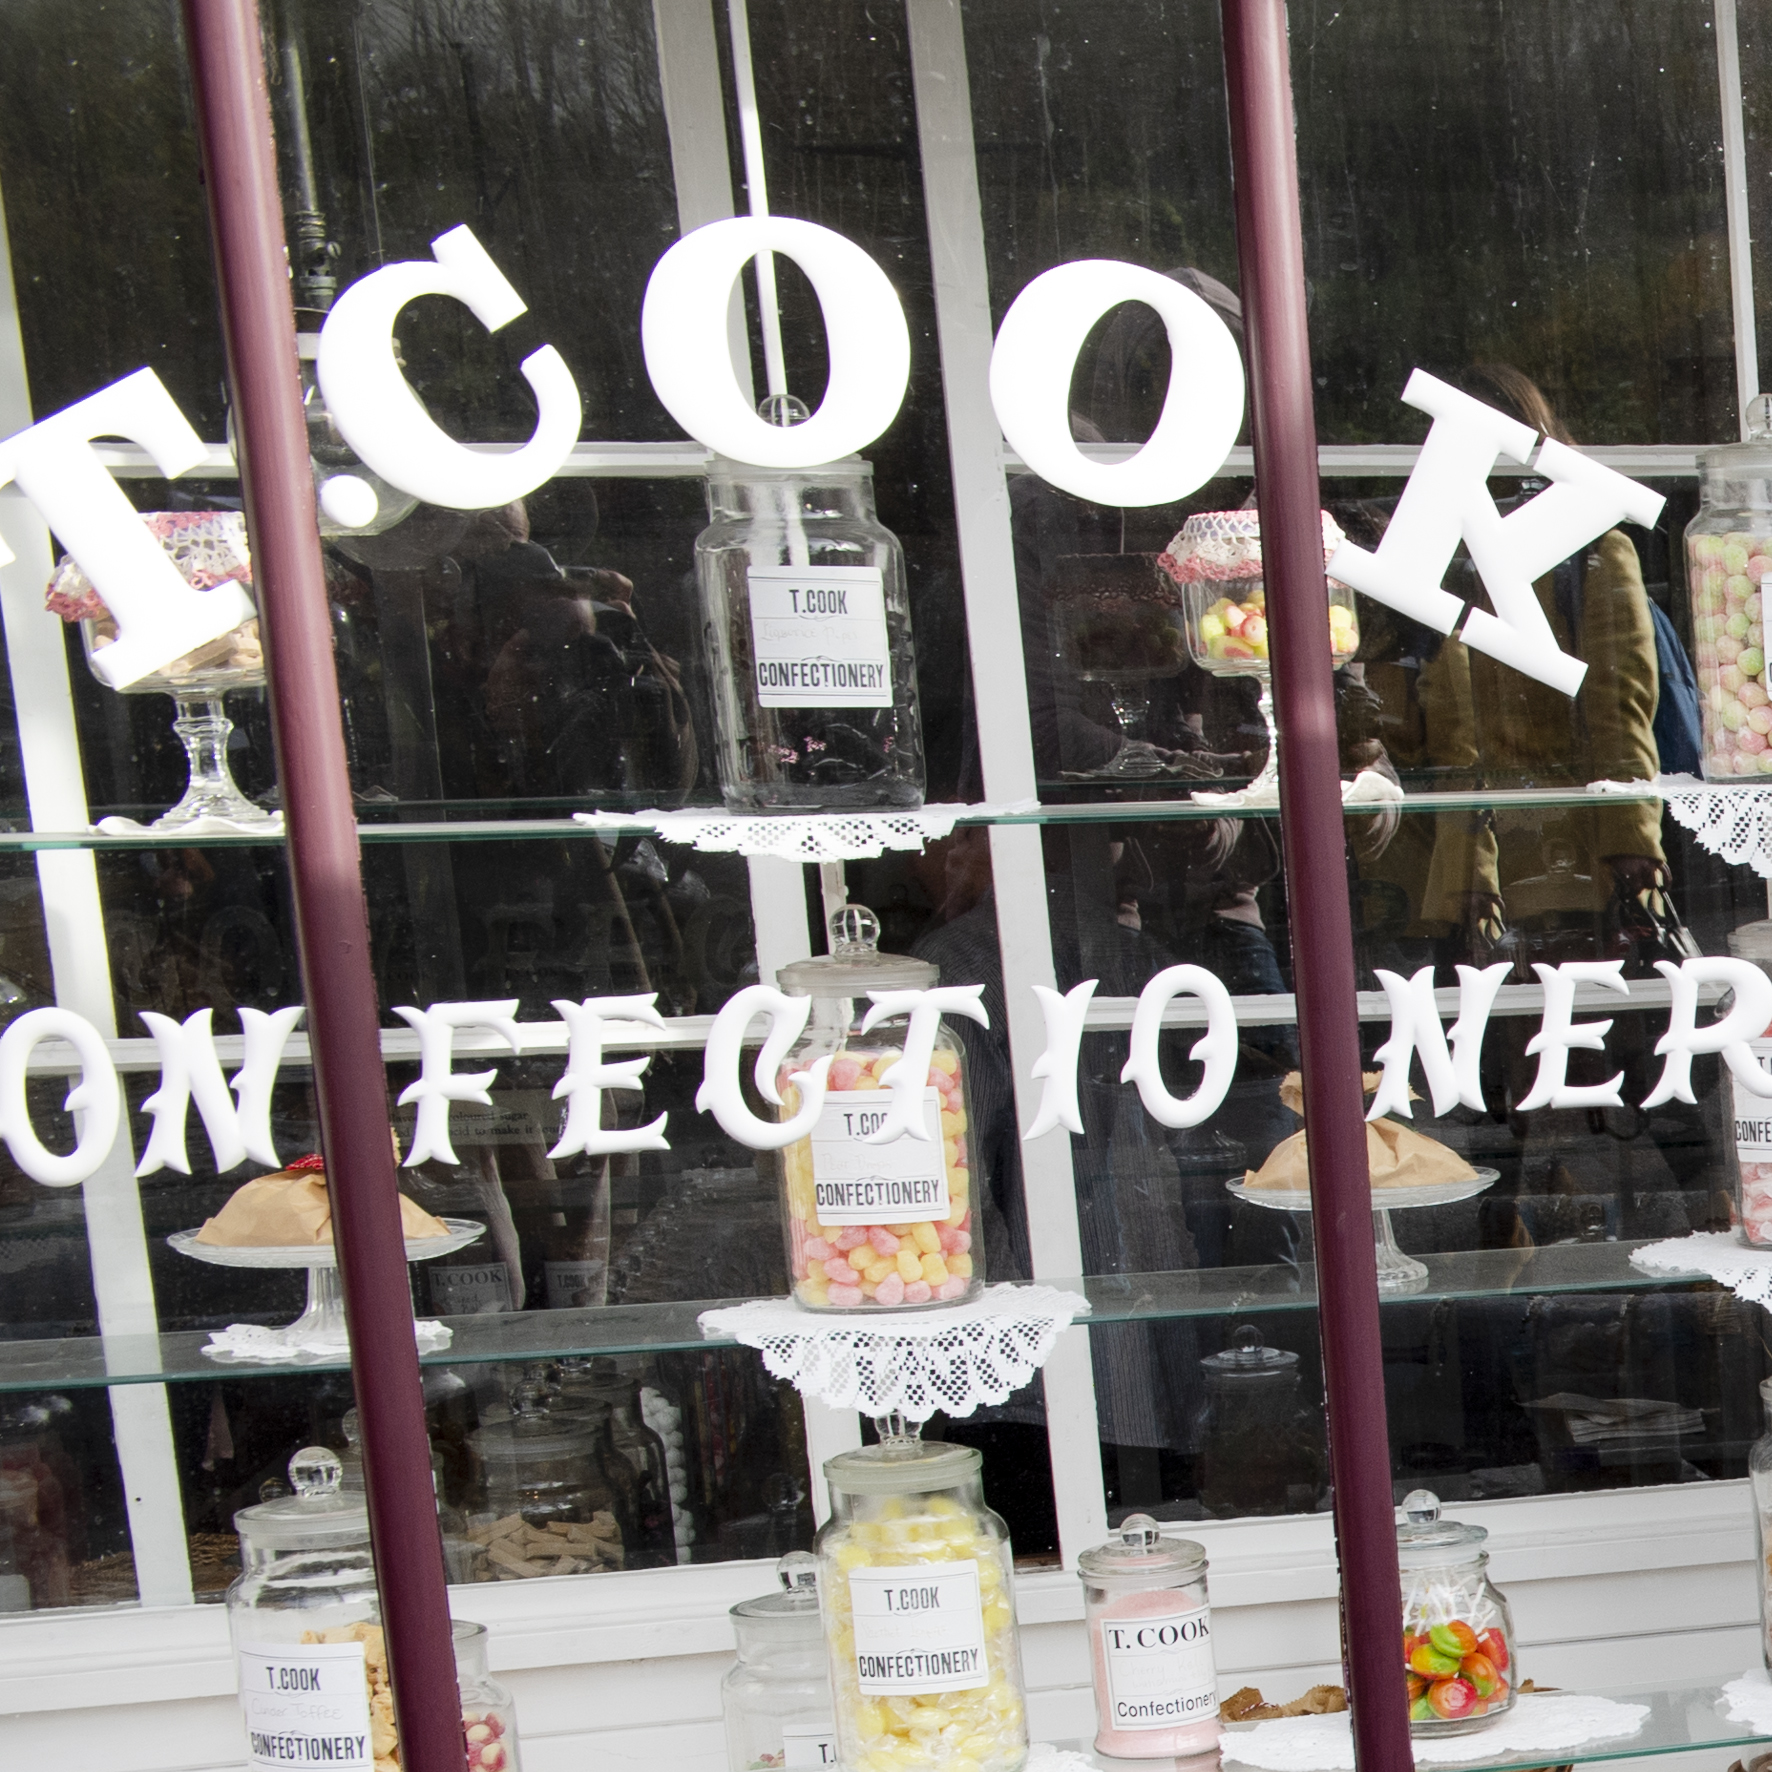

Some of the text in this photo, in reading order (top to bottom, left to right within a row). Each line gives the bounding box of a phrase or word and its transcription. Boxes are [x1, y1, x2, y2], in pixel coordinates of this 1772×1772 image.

[788, 589, 848, 614] T.COOK
[758, 662, 884, 688] CONFECTIONERY
[816, 1180, 939, 1206] CONFECTIONERY
[883, 1586, 940, 1611] T.COOK
[859, 1648, 978, 1678] CONFECTIONERY
[266, 1666, 321, 1691] T.COOK
[251, 1732, 365, 1760] CONFECTIONERY
